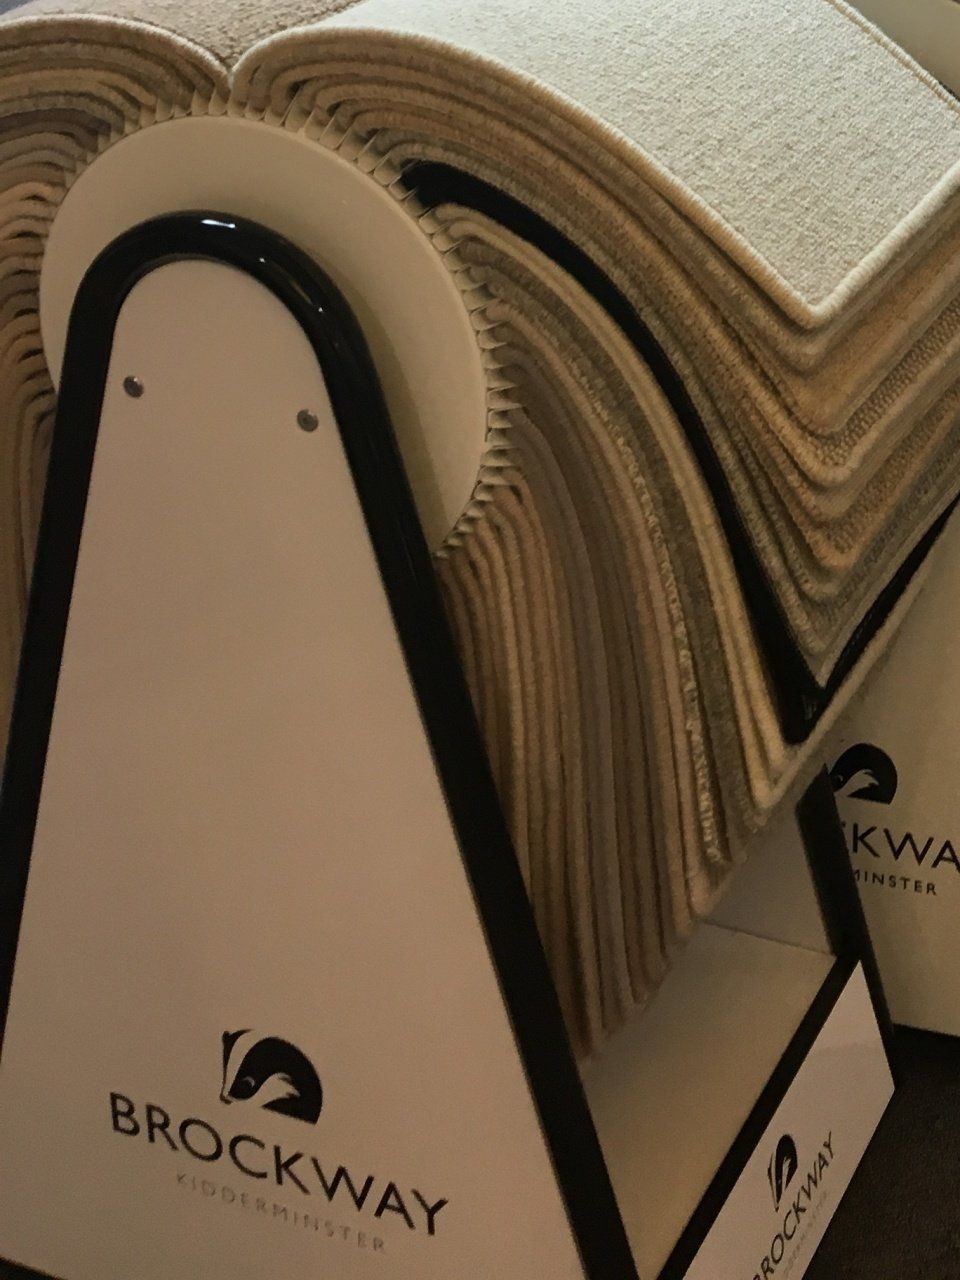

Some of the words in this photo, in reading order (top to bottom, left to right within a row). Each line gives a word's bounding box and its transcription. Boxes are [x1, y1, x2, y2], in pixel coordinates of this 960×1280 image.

[109, 1091, 449, 1237] BROCKWAY
[175, 1172, 387, 1253] KIDDERMINSTER
[753, 1130, 834, 1280] ROCKWAY
